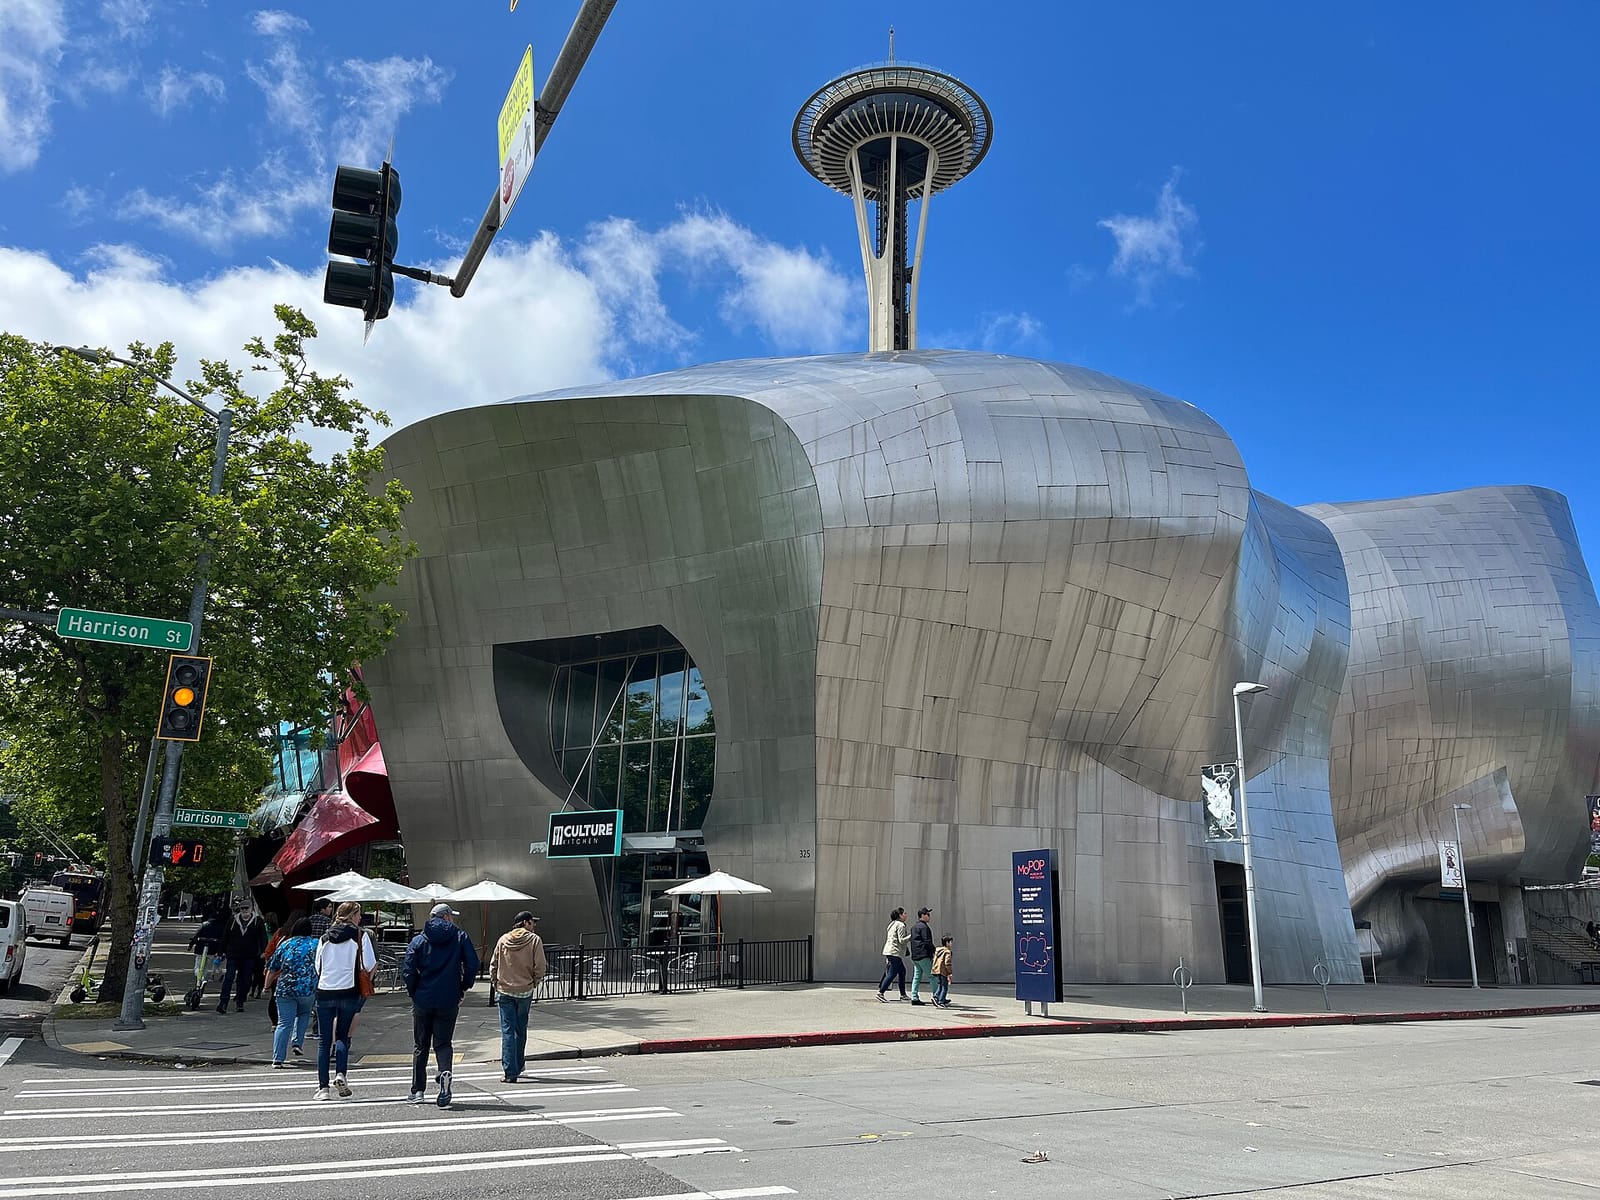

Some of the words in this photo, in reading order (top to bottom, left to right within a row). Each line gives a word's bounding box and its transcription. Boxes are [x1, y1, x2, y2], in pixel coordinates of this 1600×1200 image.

[501, 63, 529, 132] TURNING
[502, 86, 529, 154] VEHICLES
[503, 164, 515, 197] STOP
[68, 615, 149, 640] Harrison
[166, 630, 182, 644] St
[176, 810, 224, 825] Harrison
[227, 817, 236, 825] St
[563, 823, 614, 838] CULTURE
[799, 849, 811, 858] 325
[1017, 859, 1045, 875] MoPOP
